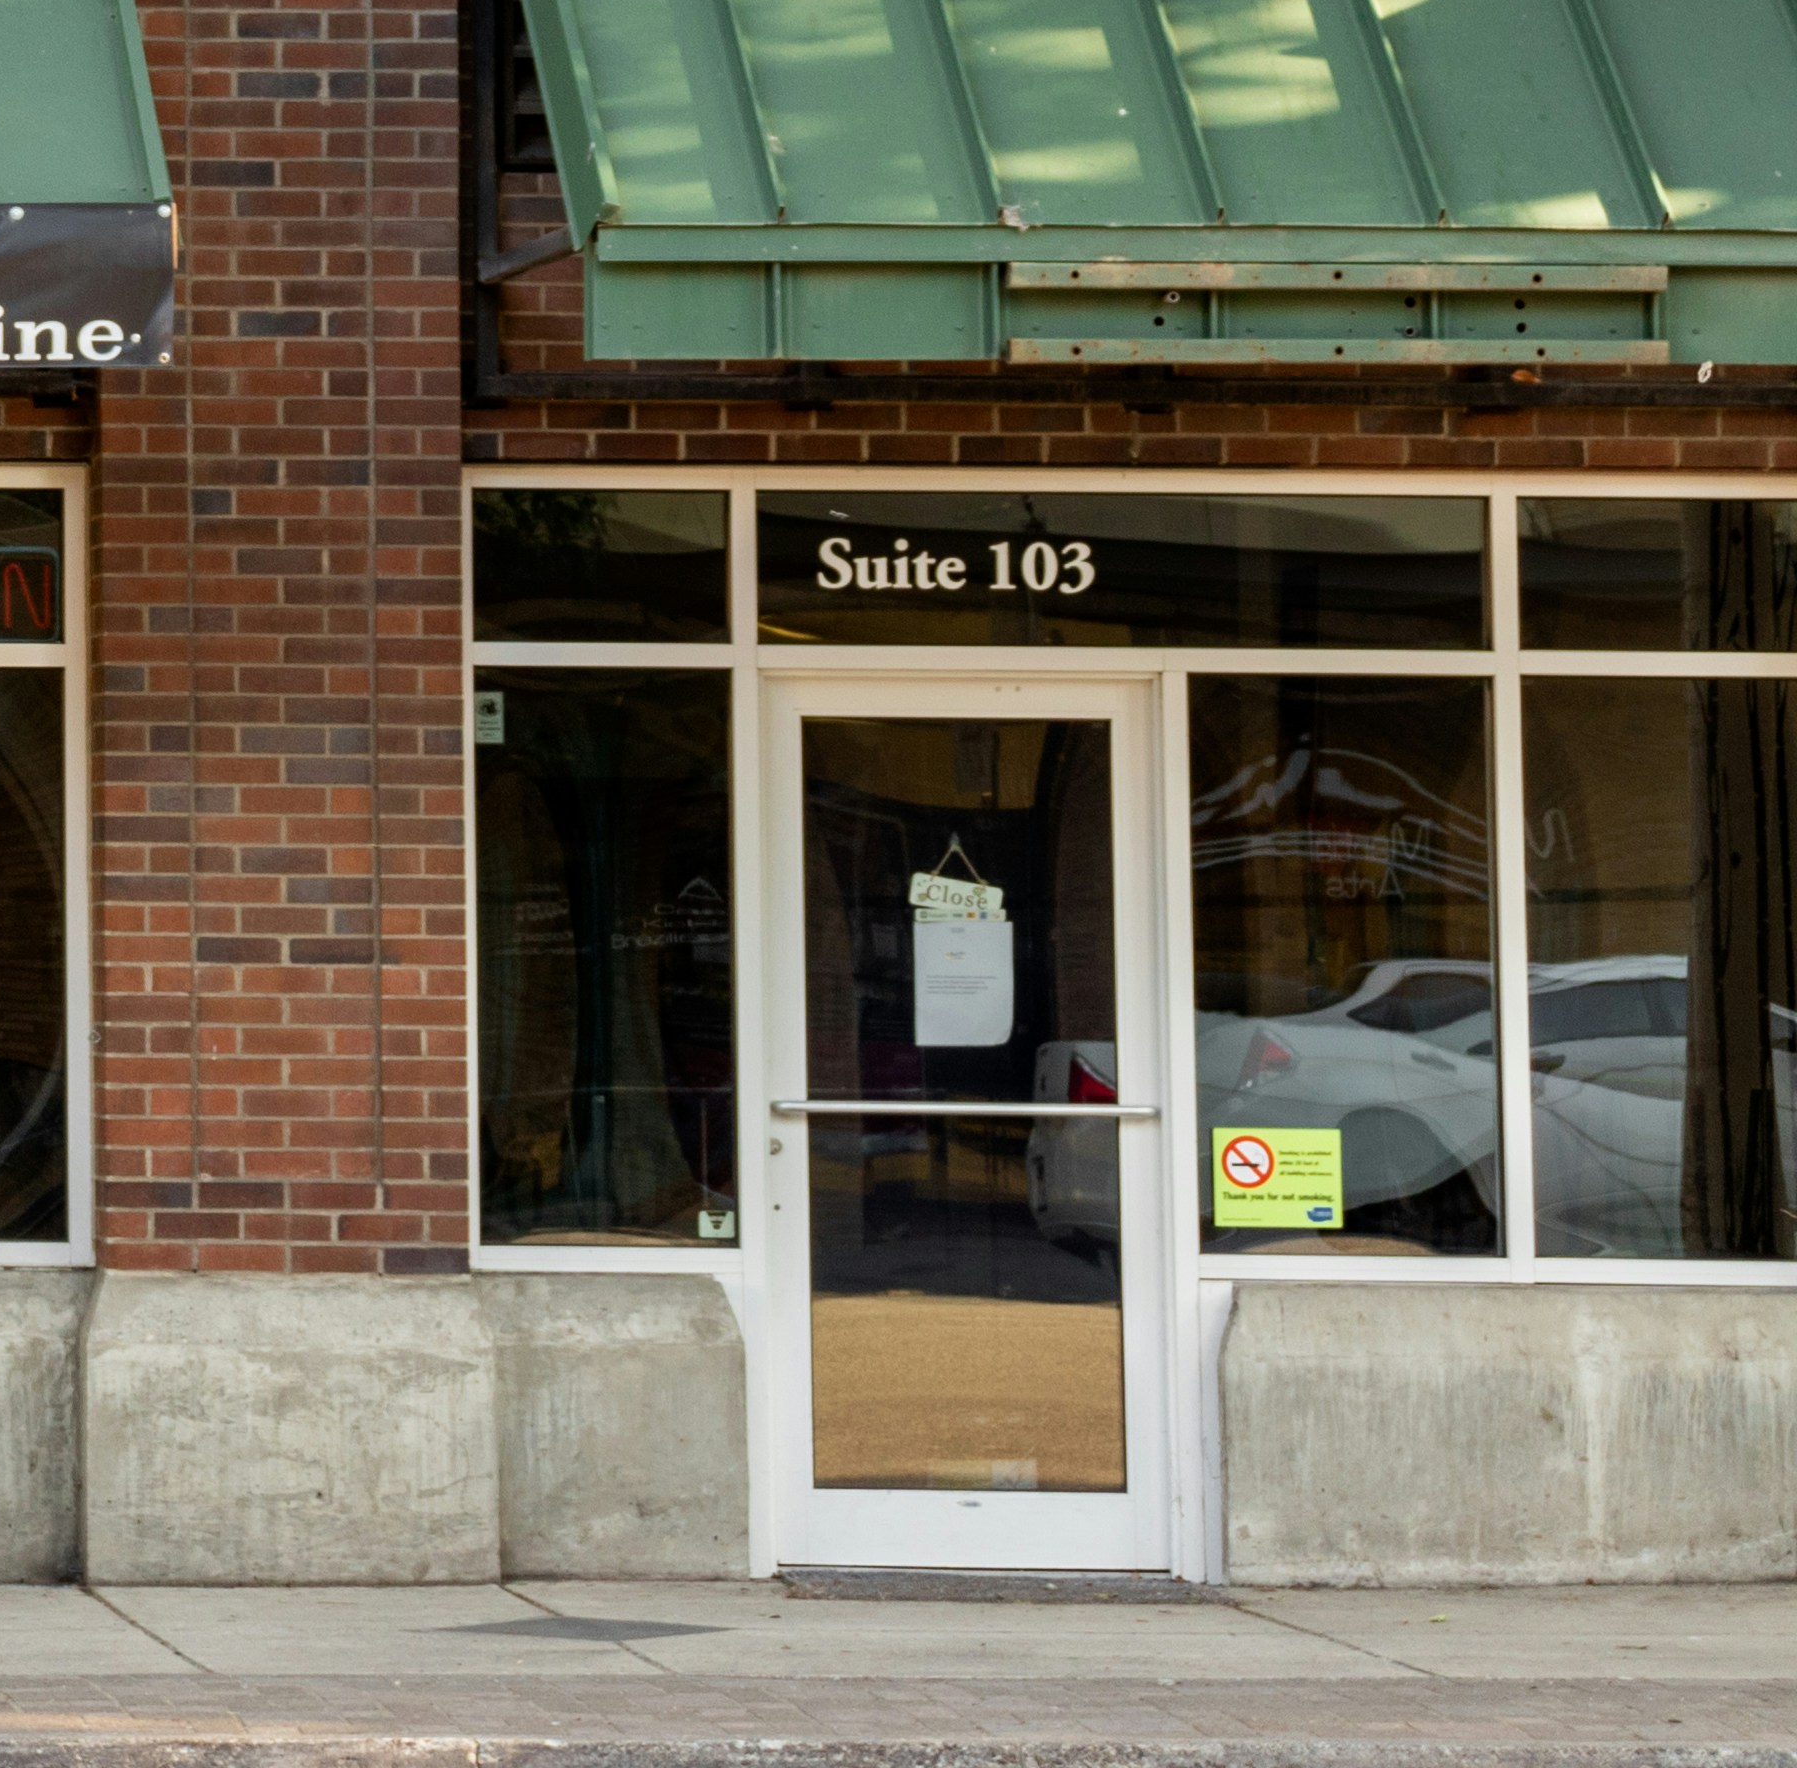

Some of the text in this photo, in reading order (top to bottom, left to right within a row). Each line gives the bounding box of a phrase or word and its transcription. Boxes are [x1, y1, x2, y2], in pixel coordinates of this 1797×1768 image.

[816, 536, 1096, 594] Suite 103
[926, 884, 988, 910] Close
[1223, 1191, 1247, 1200] Thank
[1250, 1193, 1265, 1203] you
[1267, 1192, 1278, 1200] for
[1298, 1193, 1334, 1203] smoking.
